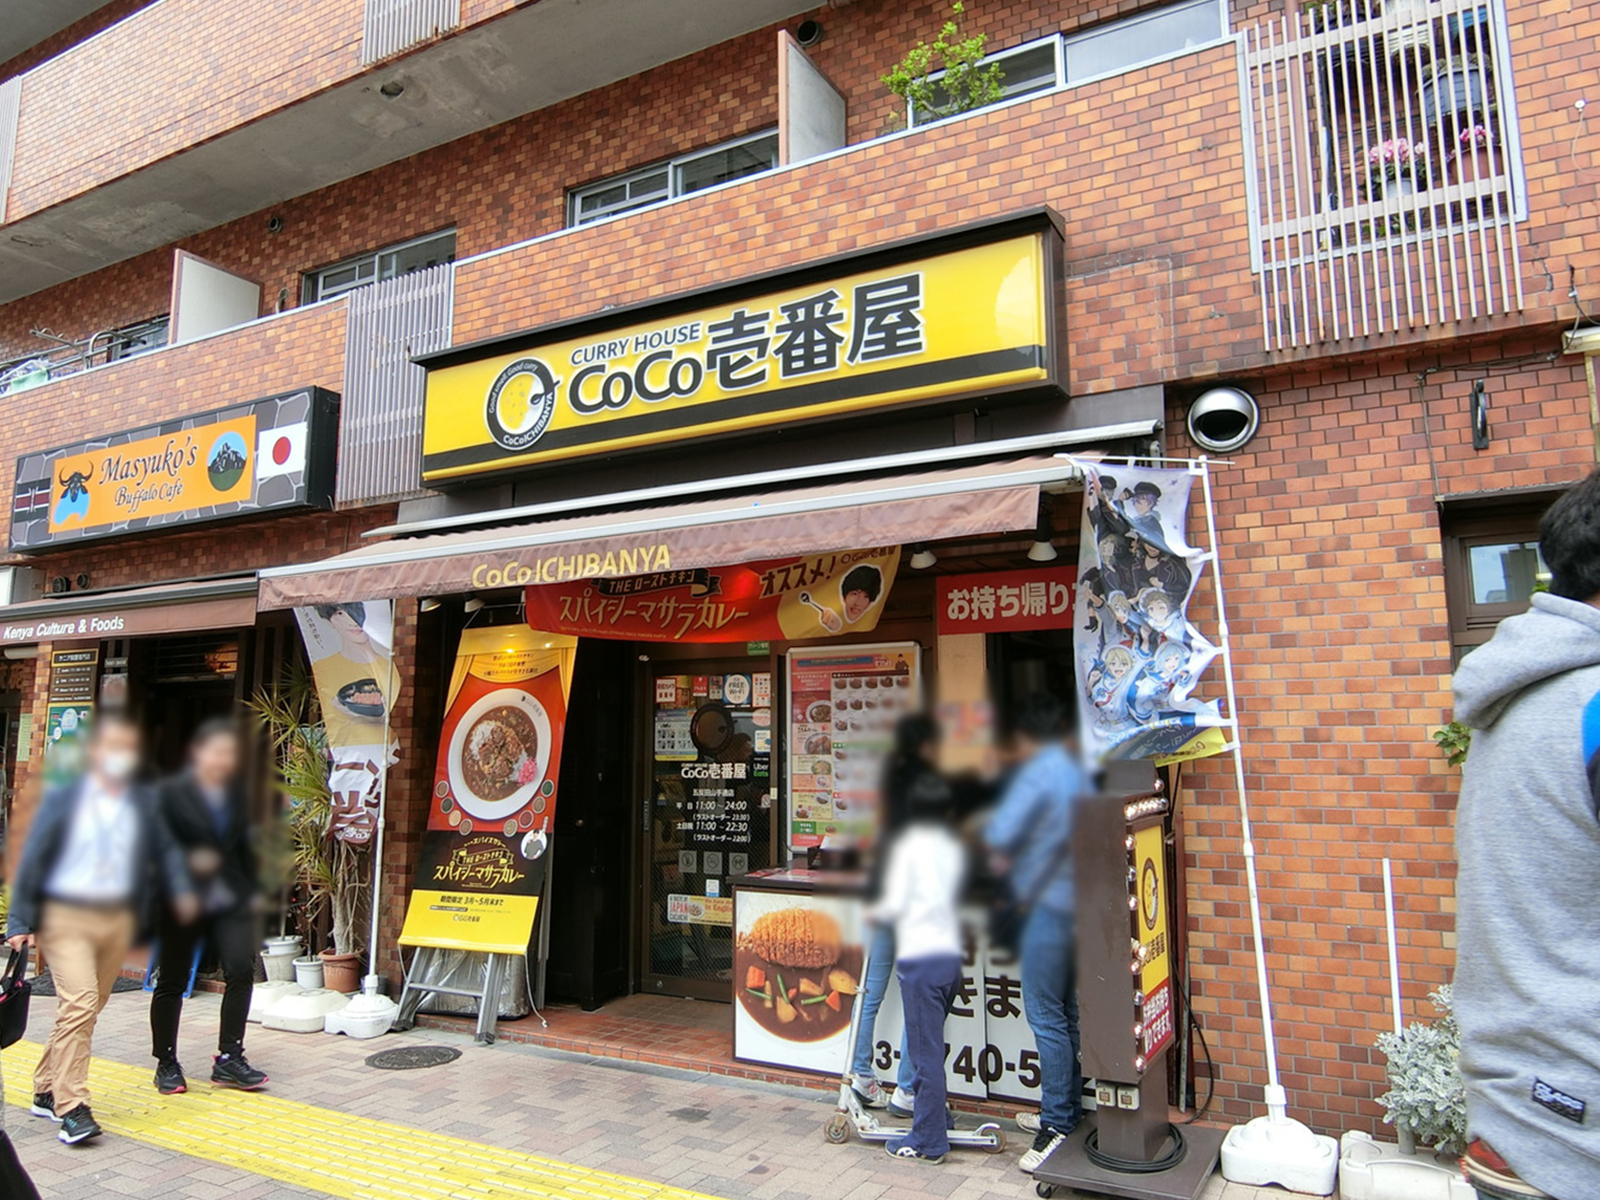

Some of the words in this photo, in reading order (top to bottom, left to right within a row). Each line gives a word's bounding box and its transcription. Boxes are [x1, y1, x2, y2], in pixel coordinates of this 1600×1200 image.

[568, 272, 924, 414] CoCo壱番屋
[570, 338, 630, 366] CURRY
[633, 323, 701, 351] HOUSE
[502, 391, 554, 445] CoCoICHIBANYA
[98, 435, 198, 487] Masyuko's
[114, 482, 158, 513] Buffalo
[608, 579, 632, 594] THE
[634, 569, 696, 591] ローストチキン
[558, 586, 749, 640] スパイシーマサラカレー
[947, 581, 1076, 621] お持ち帰り
[3, 626, 34, 641] Kenya
[36, 622, 75, 637] Culture
[77, 619, 87, 633] &
[90, 616, 124, 632] Foods
[681, 762, 747, 779] CoCo壱番屋
[753, 763, 769, 771] Uber
[753, 770, 769, 778] Eats
[695, 800, 716, 811] 11:00
[725, 801, 748, 811] 24:00
[696, 821, 717, 831] 11:00
[725, 821, 748, 832] 22:30
[432, 860, 526, 890] スパイシーマサラカレー
